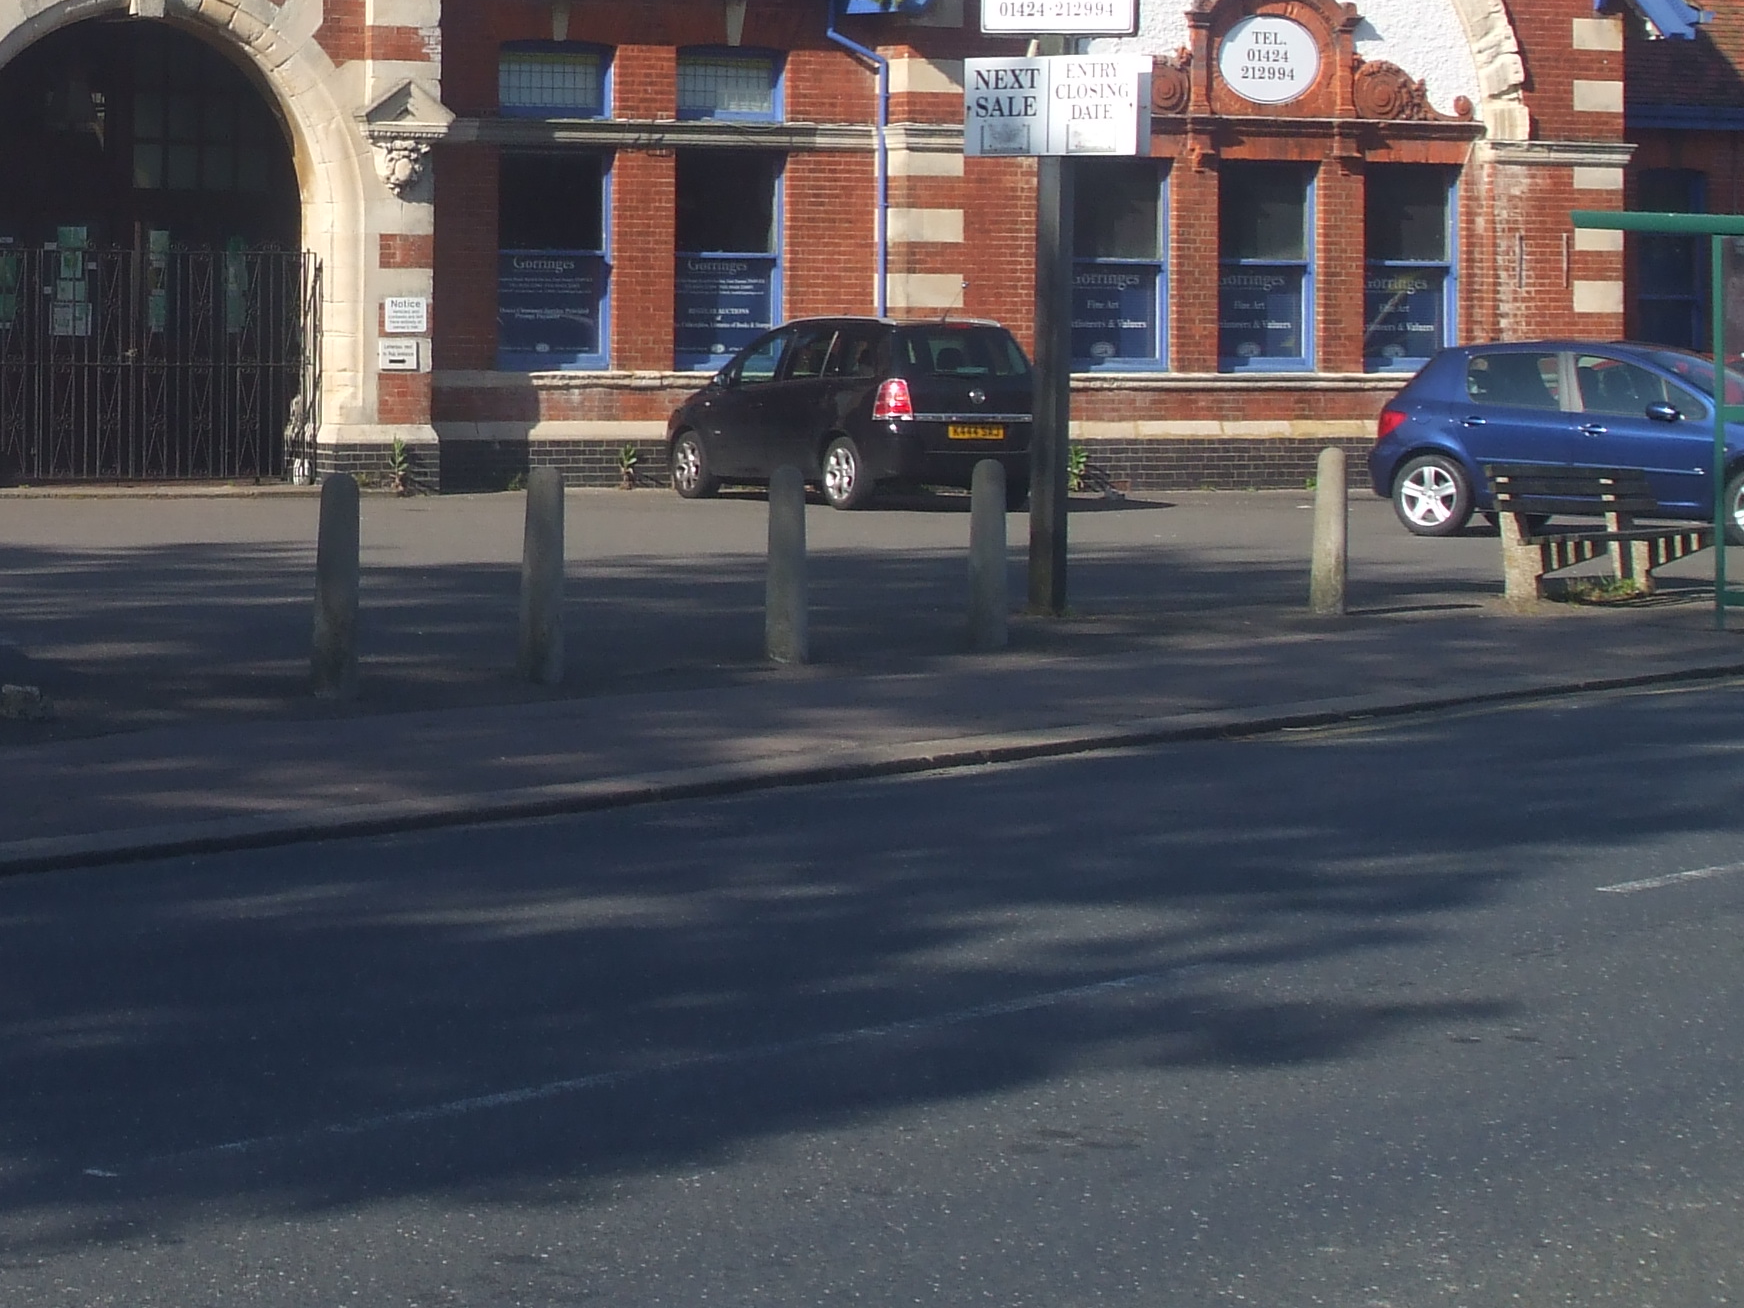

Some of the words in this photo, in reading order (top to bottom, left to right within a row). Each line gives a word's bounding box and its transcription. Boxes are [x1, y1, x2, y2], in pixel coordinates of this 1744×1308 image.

[1252, 32, 1286, 45] TEL.
[1247, 49, 1288, 62] 01424
[1066, 63, 1118, 78] ENTRY
[1241, 66, 1295, 80] 212994
[975, 69, 1040, 90] NEXT
[1056, 84, 1128, 99] CLOSING
[976, 96, 1037, 118] SALE
[1072, 105, 1113, 120] DATE
[513, 256, 574, 272] Gorringes
[688, 260, 747, 274] Gorringes
[391, 300, 421, 308] Notice
[1087, 300, 1104, 308] Fine
